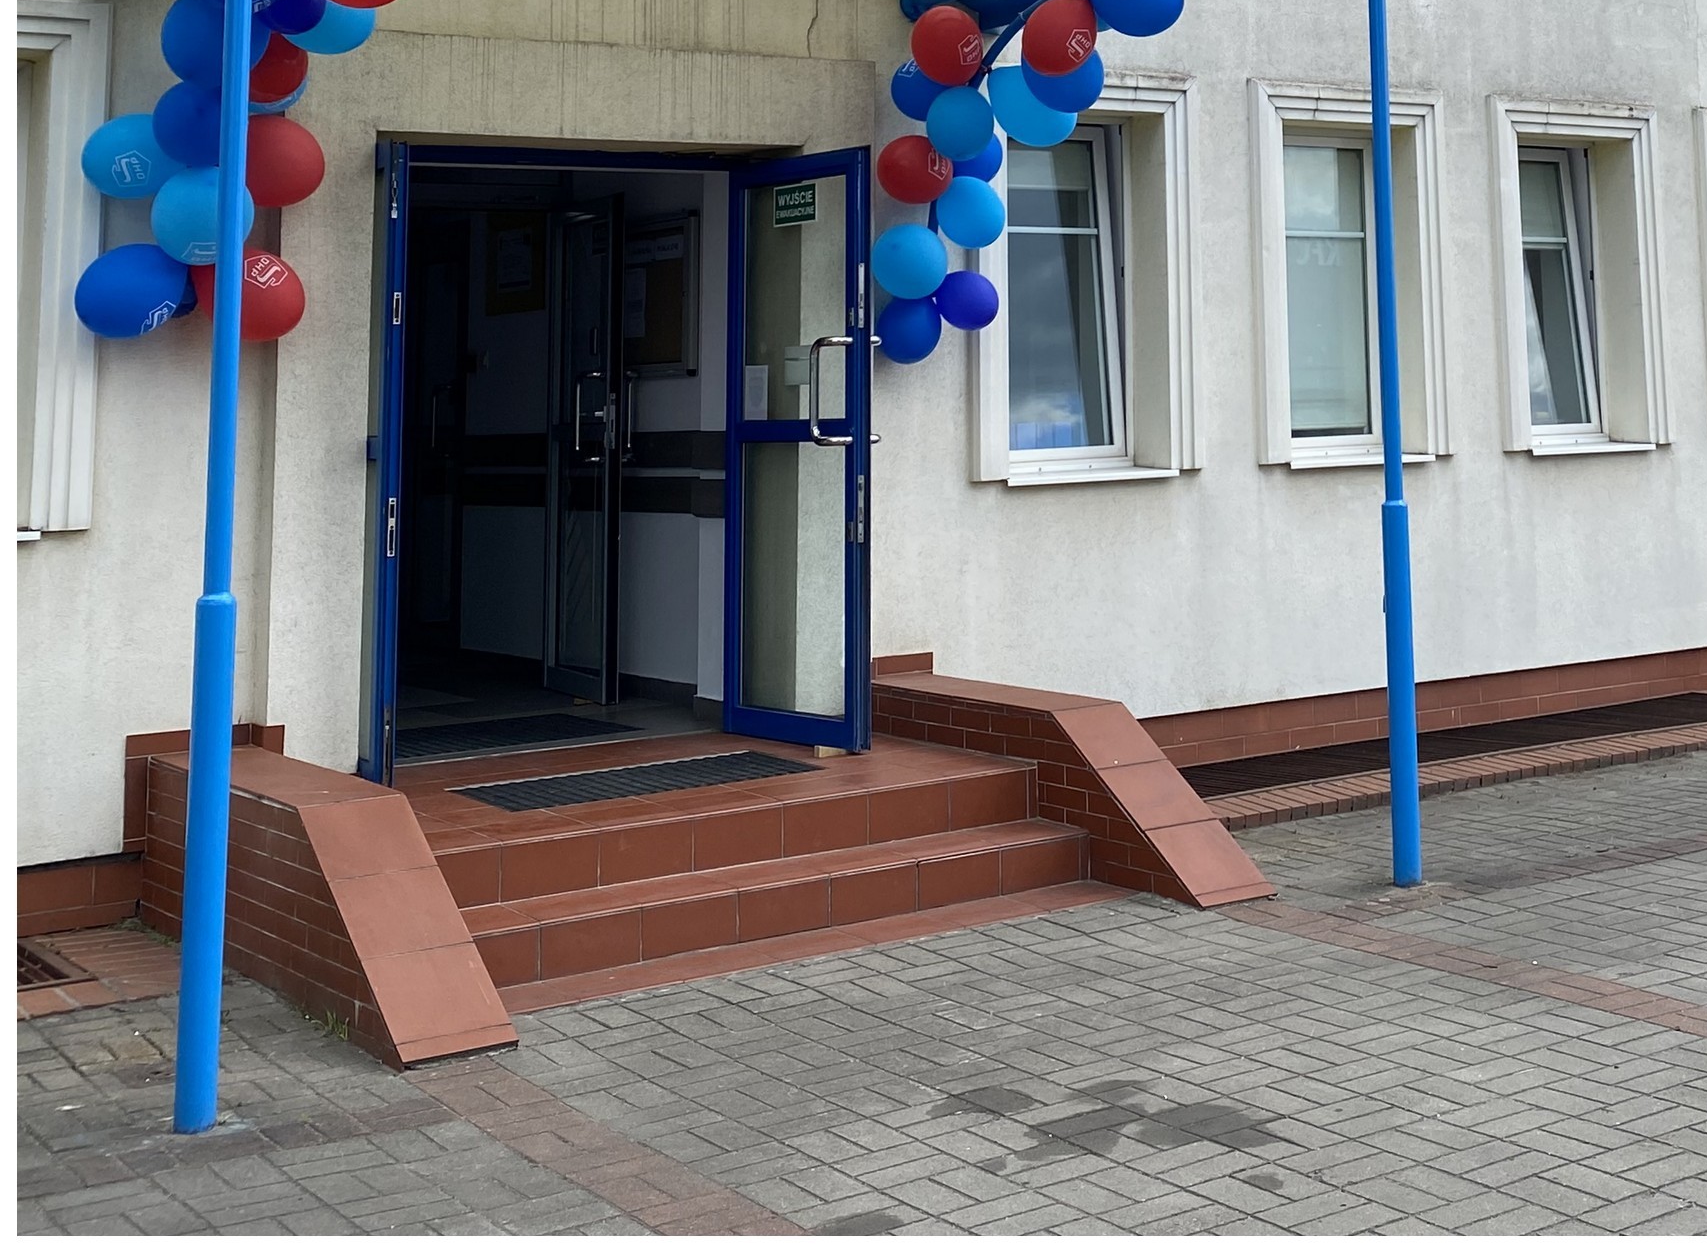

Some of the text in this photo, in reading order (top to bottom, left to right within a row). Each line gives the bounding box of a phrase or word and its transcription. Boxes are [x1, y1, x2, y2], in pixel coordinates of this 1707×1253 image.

[1075, 33, 1091, 49] OHP
[131, 157, 145, 180] OHP
[777, 190, 813, 206] WYJŚCIE
[251, 257, 270, 277] OHP
